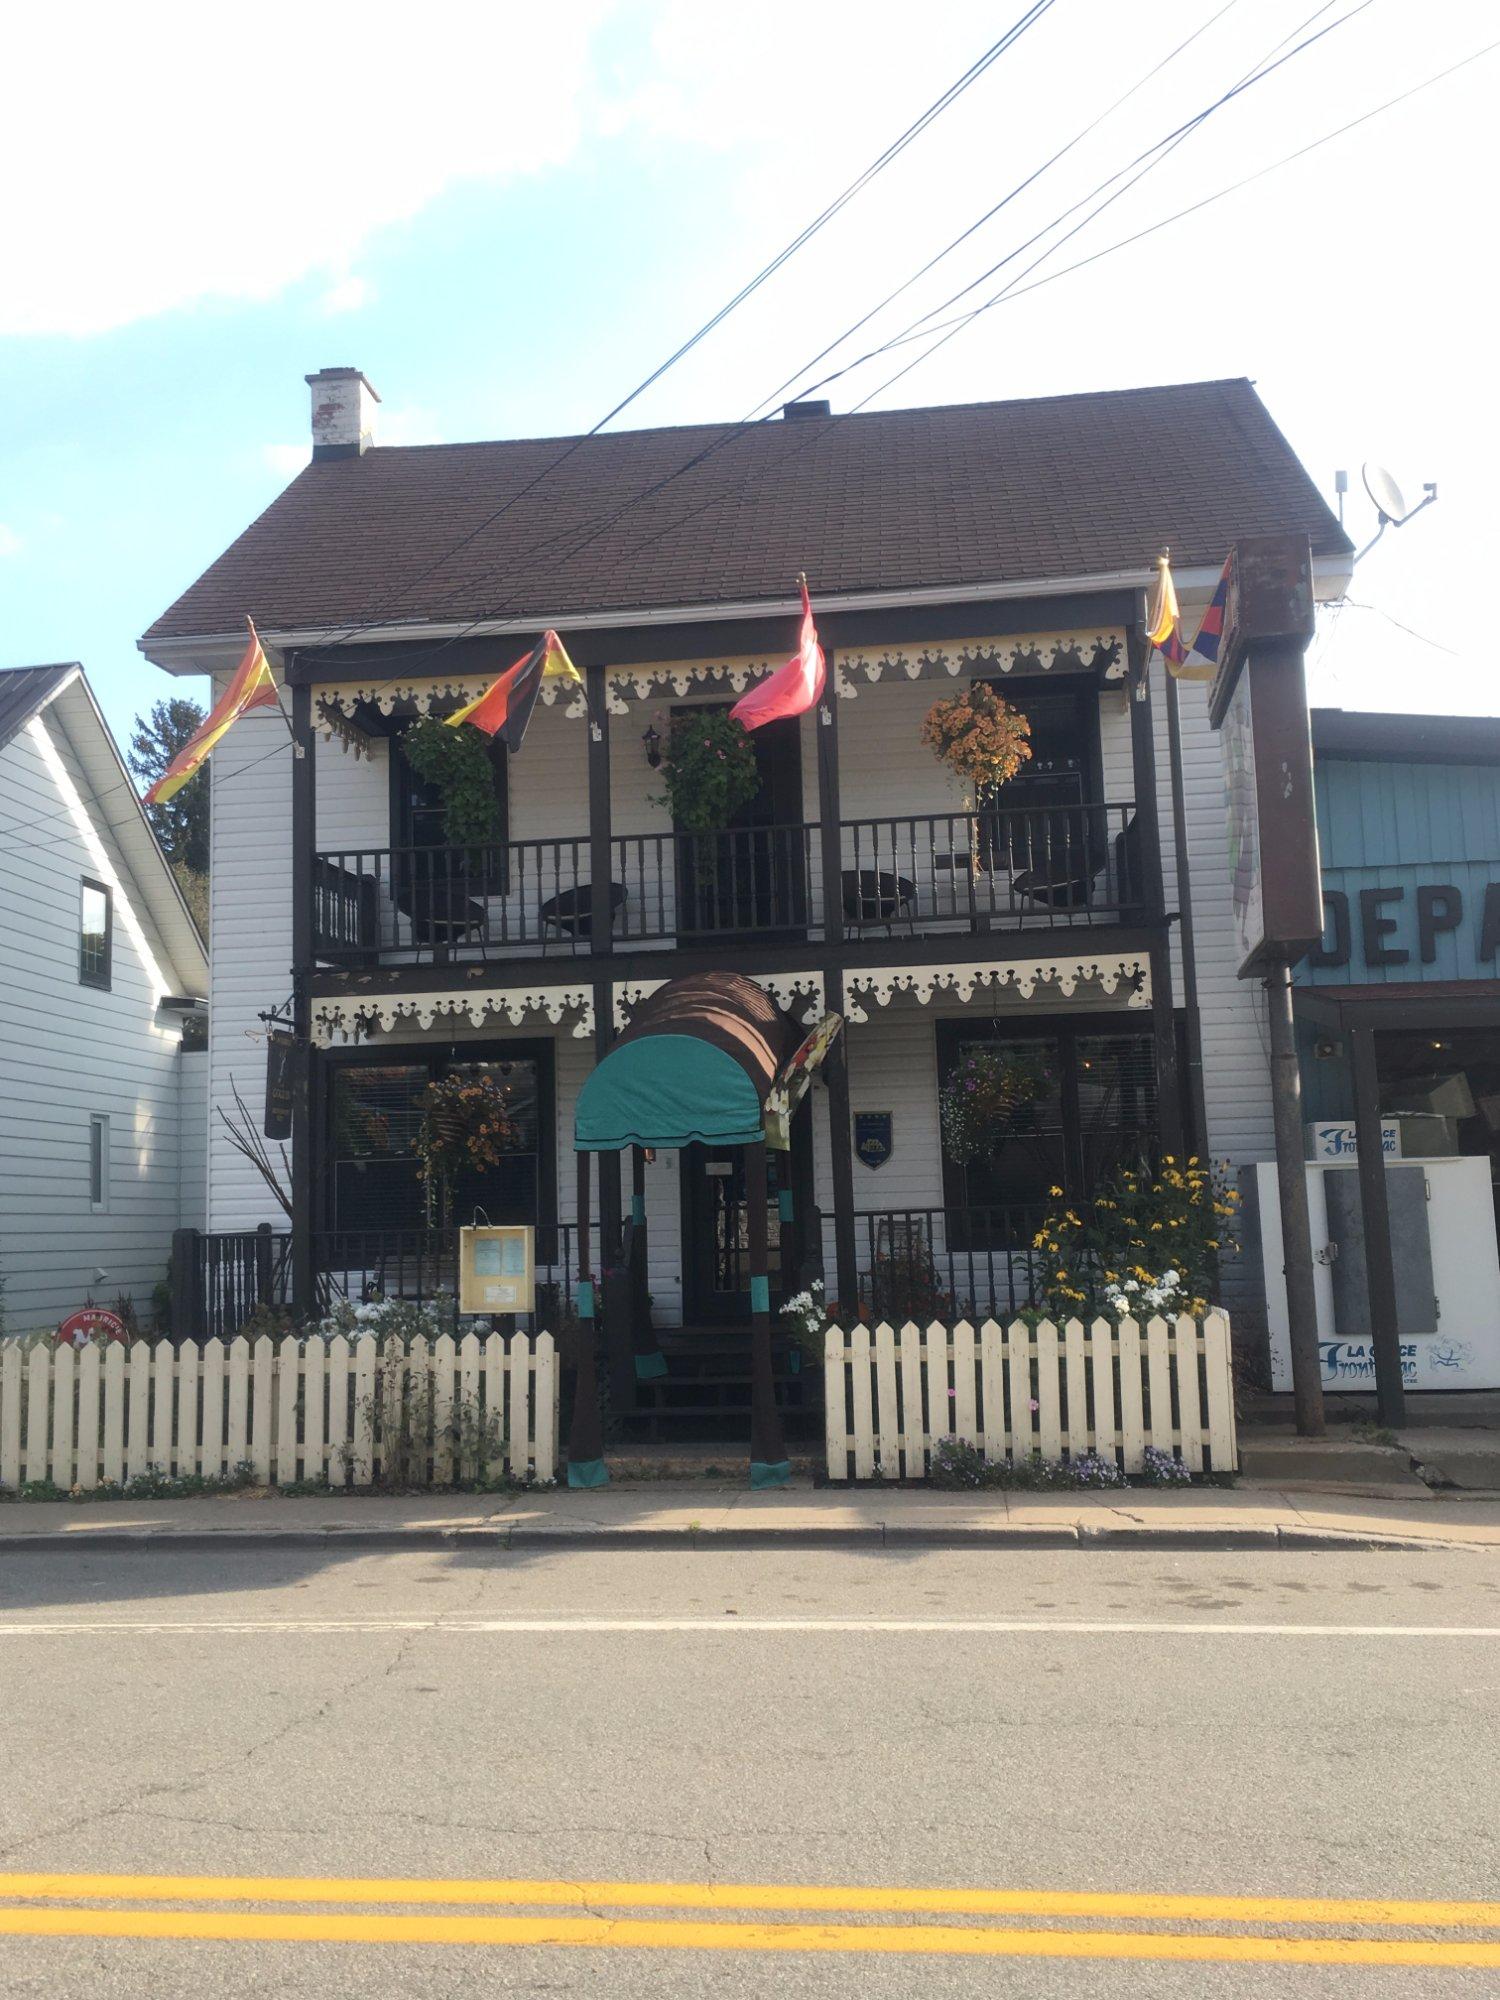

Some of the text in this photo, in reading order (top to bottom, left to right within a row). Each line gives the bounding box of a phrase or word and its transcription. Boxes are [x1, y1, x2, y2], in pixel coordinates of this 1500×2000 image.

[1319, 1129, 1396, 1155] Froac
[1318, 1342, 1417, 1381] Frontac
[1347, 1345, 1365, 1357] LA
